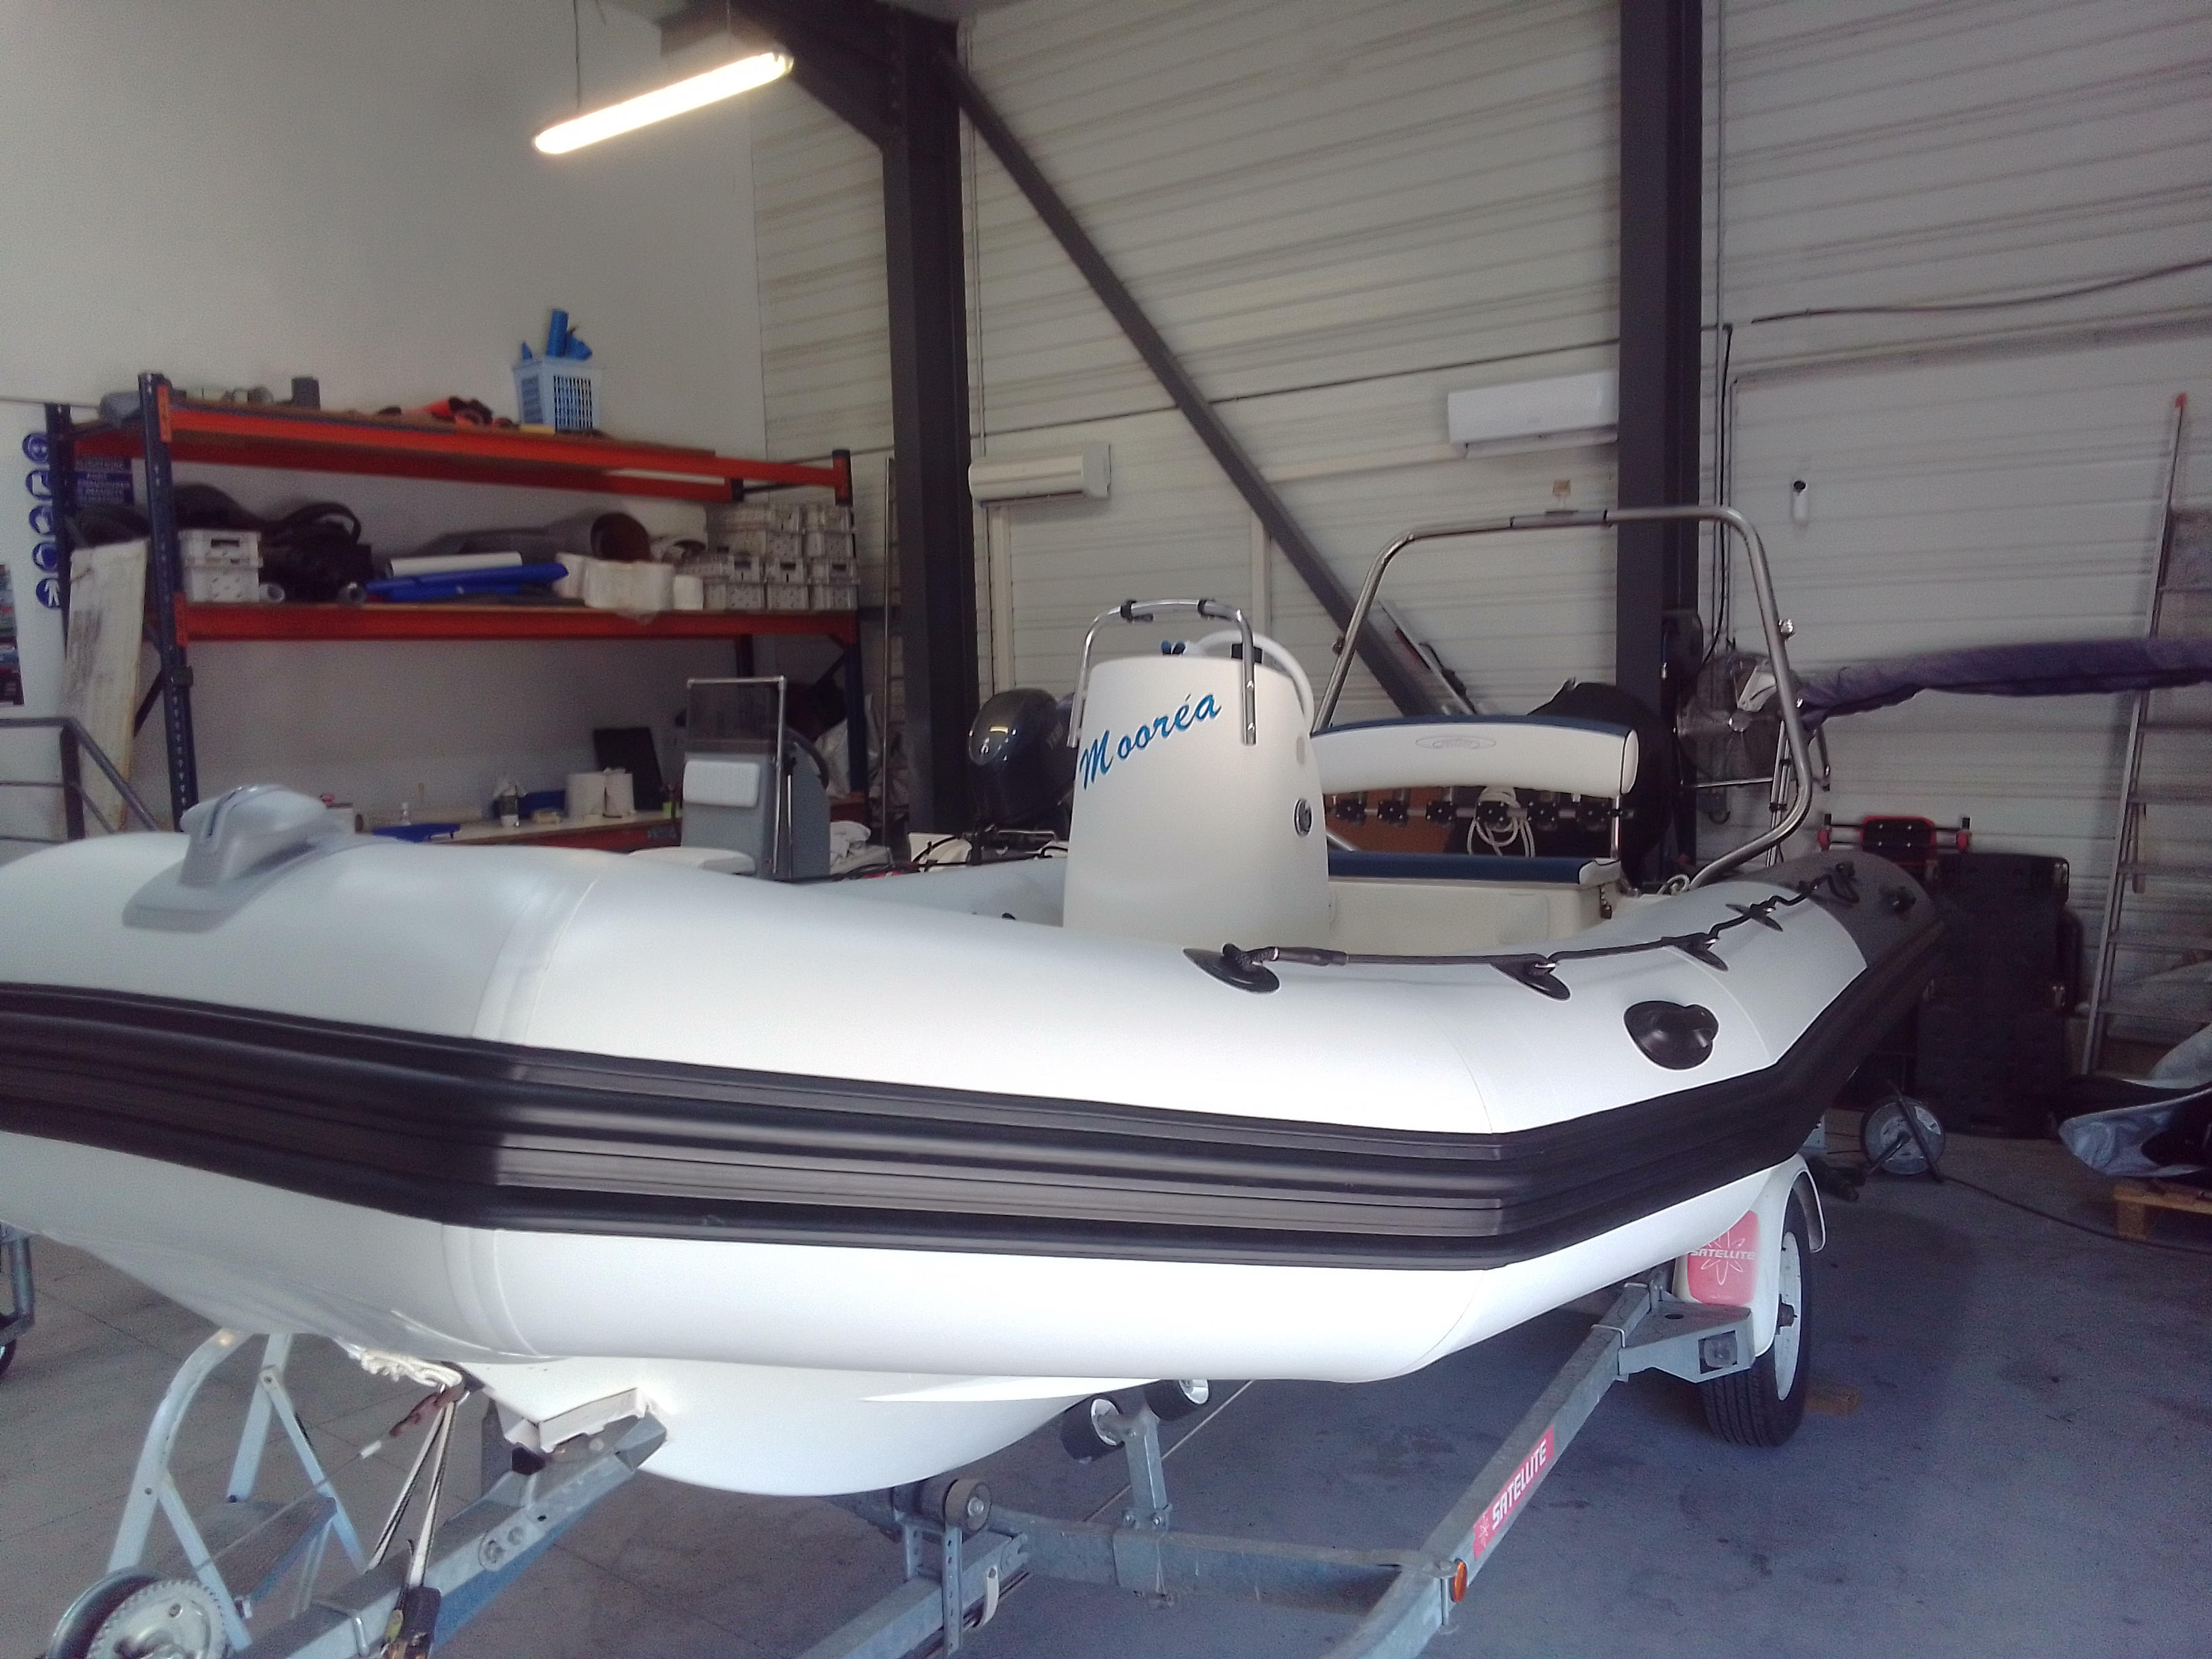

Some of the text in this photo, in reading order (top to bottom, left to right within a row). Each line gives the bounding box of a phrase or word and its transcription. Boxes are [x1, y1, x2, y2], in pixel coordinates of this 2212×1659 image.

[1079, 693, 1222, 790] Mooréa
[1689, 1248, 1757, 1259] SATELLITE
[1492, 1439, 1547, 1530] SATELLITE
